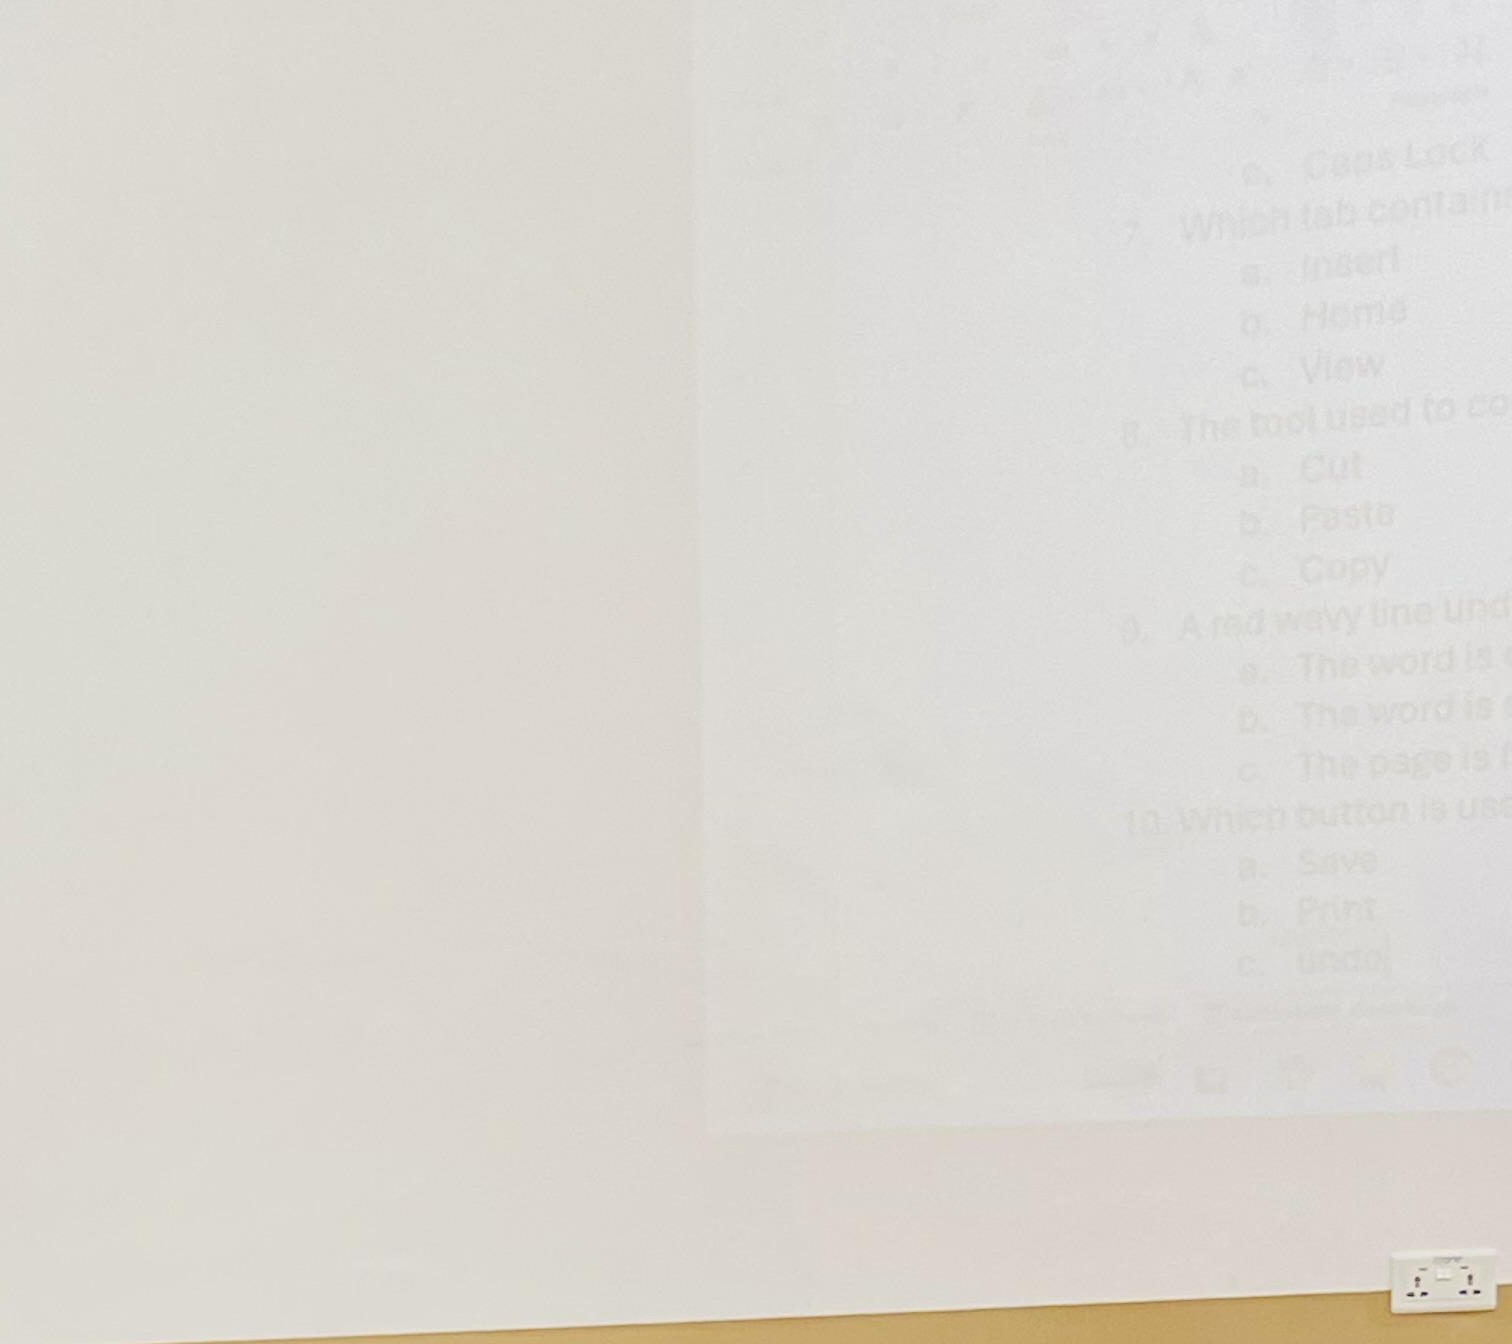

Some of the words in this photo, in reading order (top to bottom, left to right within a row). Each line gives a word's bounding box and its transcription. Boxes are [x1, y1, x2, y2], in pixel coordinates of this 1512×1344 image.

[1302, 146, 1396, 181] Caps
[1405, 135, 1489, 167] Lock
[1179, 205, 1290, 243] Which
[1301, 198, 1357, 231] tab
[1302, 243, 1400, 282] Insert
[1302, 296, 1408, 331] Home
[1300, 351, 1385, 385] View
[1180, 413, 1241, 444] The
[1251, 406, 1316, 438] tool
[1326, 396, 1411, 430] used
[1422, 396, 1455, 422] to
[1468, 392, 1510, 418] co
[1300, 451, 1363, 483] Cut
[1300, 500, 1396, 533] Paste
[1299, 552, 1392, 588] Copy
[1178, 612, 1202, 640] A
[1211, 608, 1264, 638] red
[1275, 605, 1361, 636] wavy
[1370, 598, 1432, 628] line
[1444, 589, 1512, 623] und
[1298, 652, 1359, 682] The
[1369, 645, 1454, 675] word
[1465, 640, 1493, 671] is
[1298, 699, 1359, 730] The
[1369, 694, 1454, 723] word
[1465, 690, 1492, 719] is
[1298, 752, 1359, 781] The
[1369, 749, 1451, 779] page
[1462, 745, 1490, 771] is
[1177, 805, 1287, 835] Which
[1297, 799, 1409, 829] button
[1420, 794, 1446, 822] is
[1457, 794, 1512, 821] use
[1298, 849, 1378, 876] Save
[1298, 895, 1377, 926] Print
[1297, 949, 1384, 976] undo
